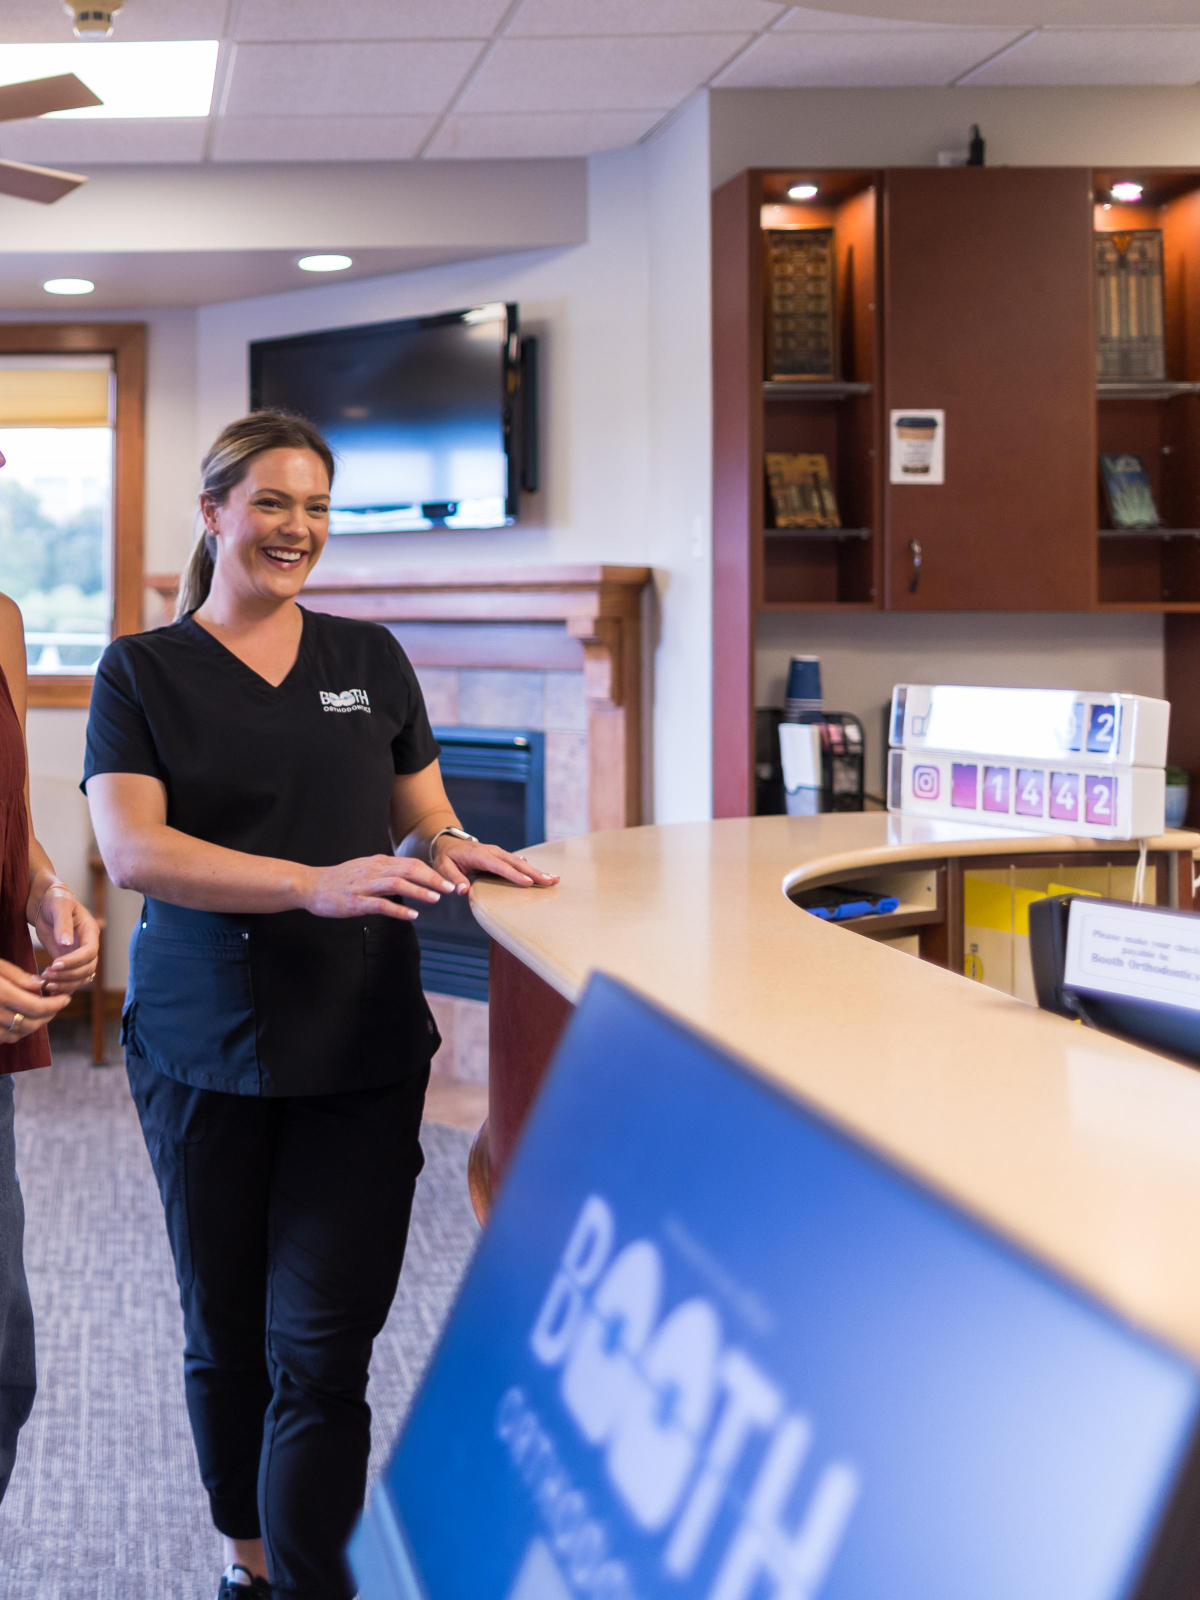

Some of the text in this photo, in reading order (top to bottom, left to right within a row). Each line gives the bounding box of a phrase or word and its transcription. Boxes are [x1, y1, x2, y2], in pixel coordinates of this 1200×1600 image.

[319, 688, 370, 707] BOOTH
[991, 774, 1111, 815] 1442
[1092, 929, 1121, 942] Please
[1124, 936, 1148, 947] make
[1151, 941, 1172, 951] your
[1121, 947, 1156, 959] payable
[1091, 952, 1200, 982] Booth Orthodontics
[530, 1193, 860, 1600] BOOTH
